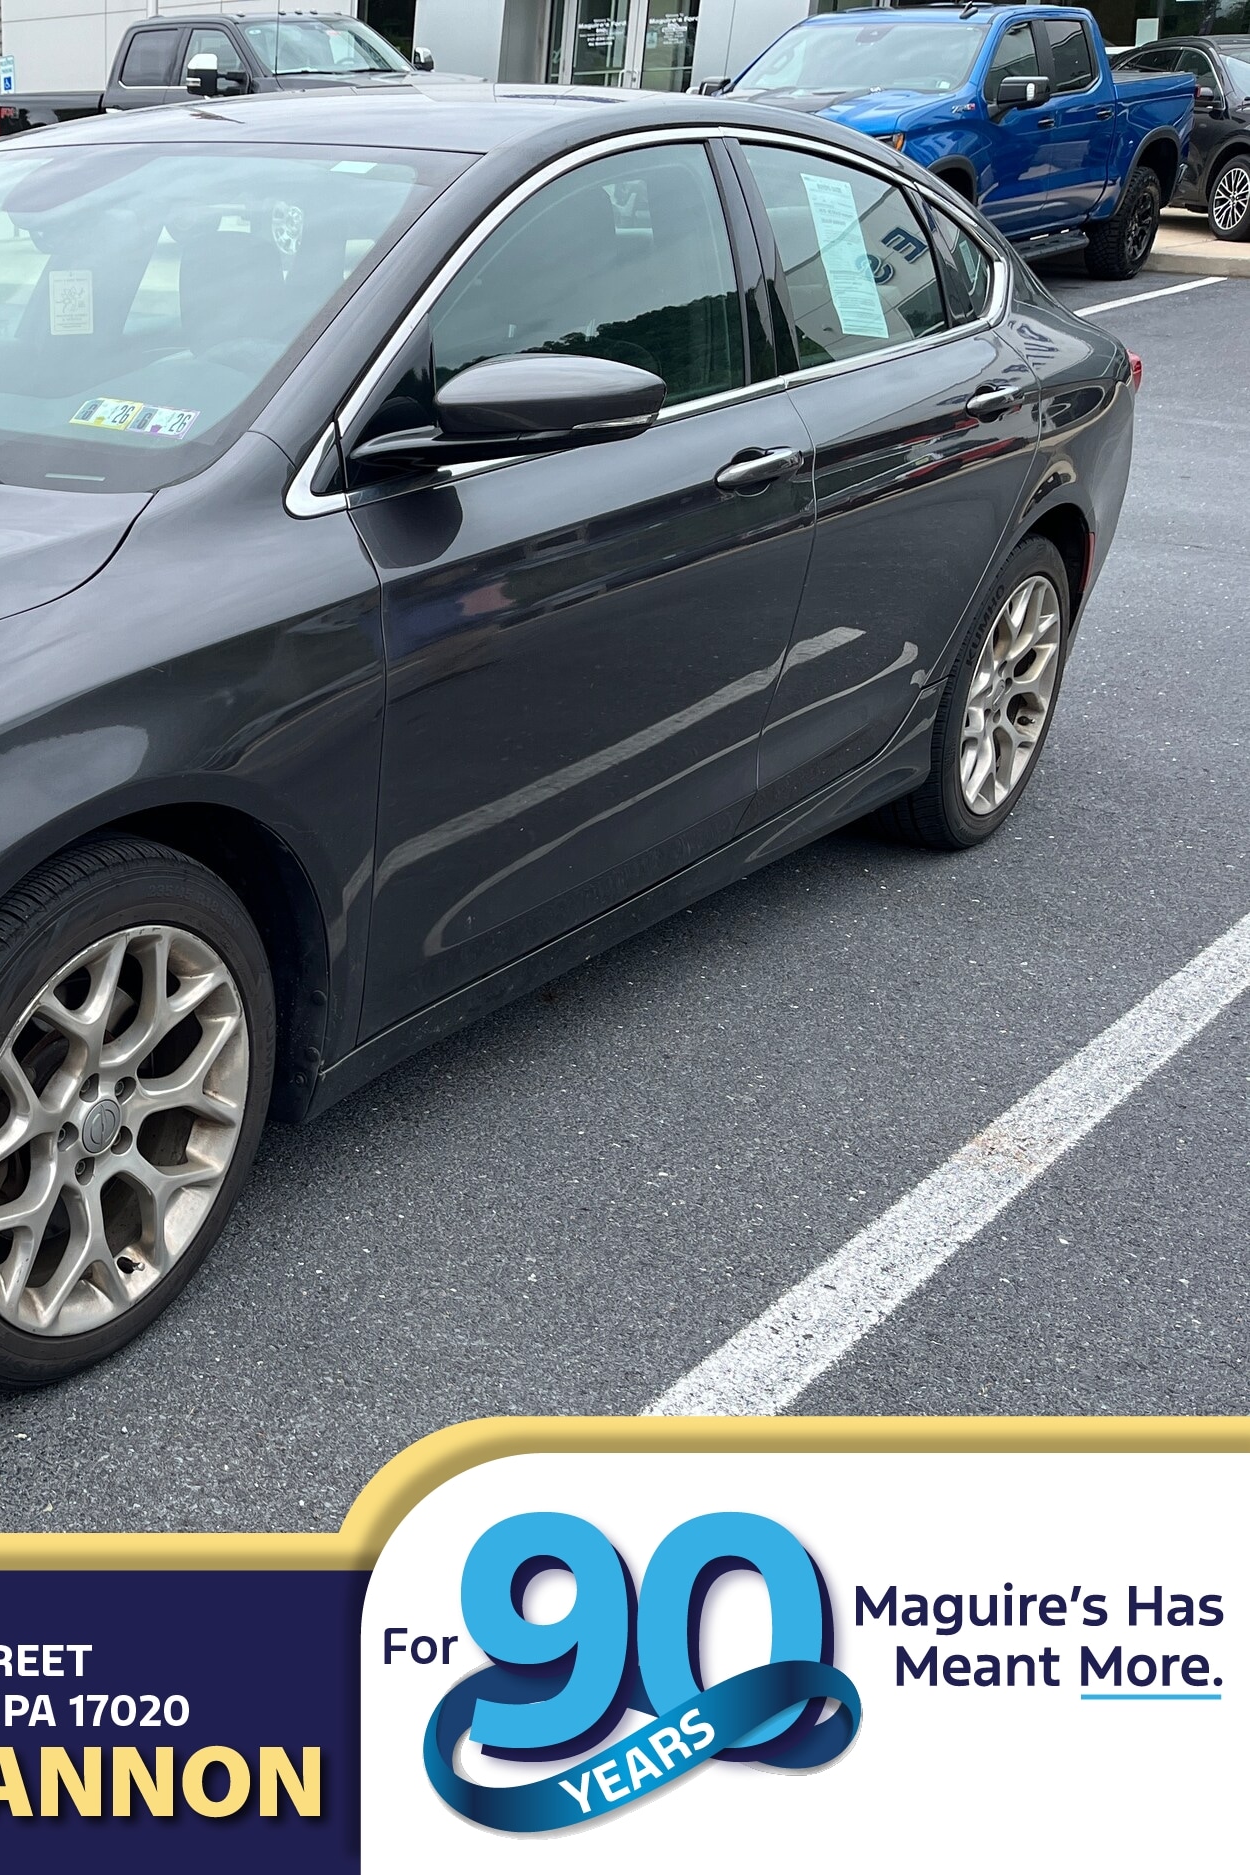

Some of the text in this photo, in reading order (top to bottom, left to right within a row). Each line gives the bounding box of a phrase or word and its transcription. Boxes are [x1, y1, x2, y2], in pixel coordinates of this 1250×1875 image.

[112, 405, 135, 424] 26
[168, 413, 191, 432] 26
[965, 584, 1005, 667] KUMHO
